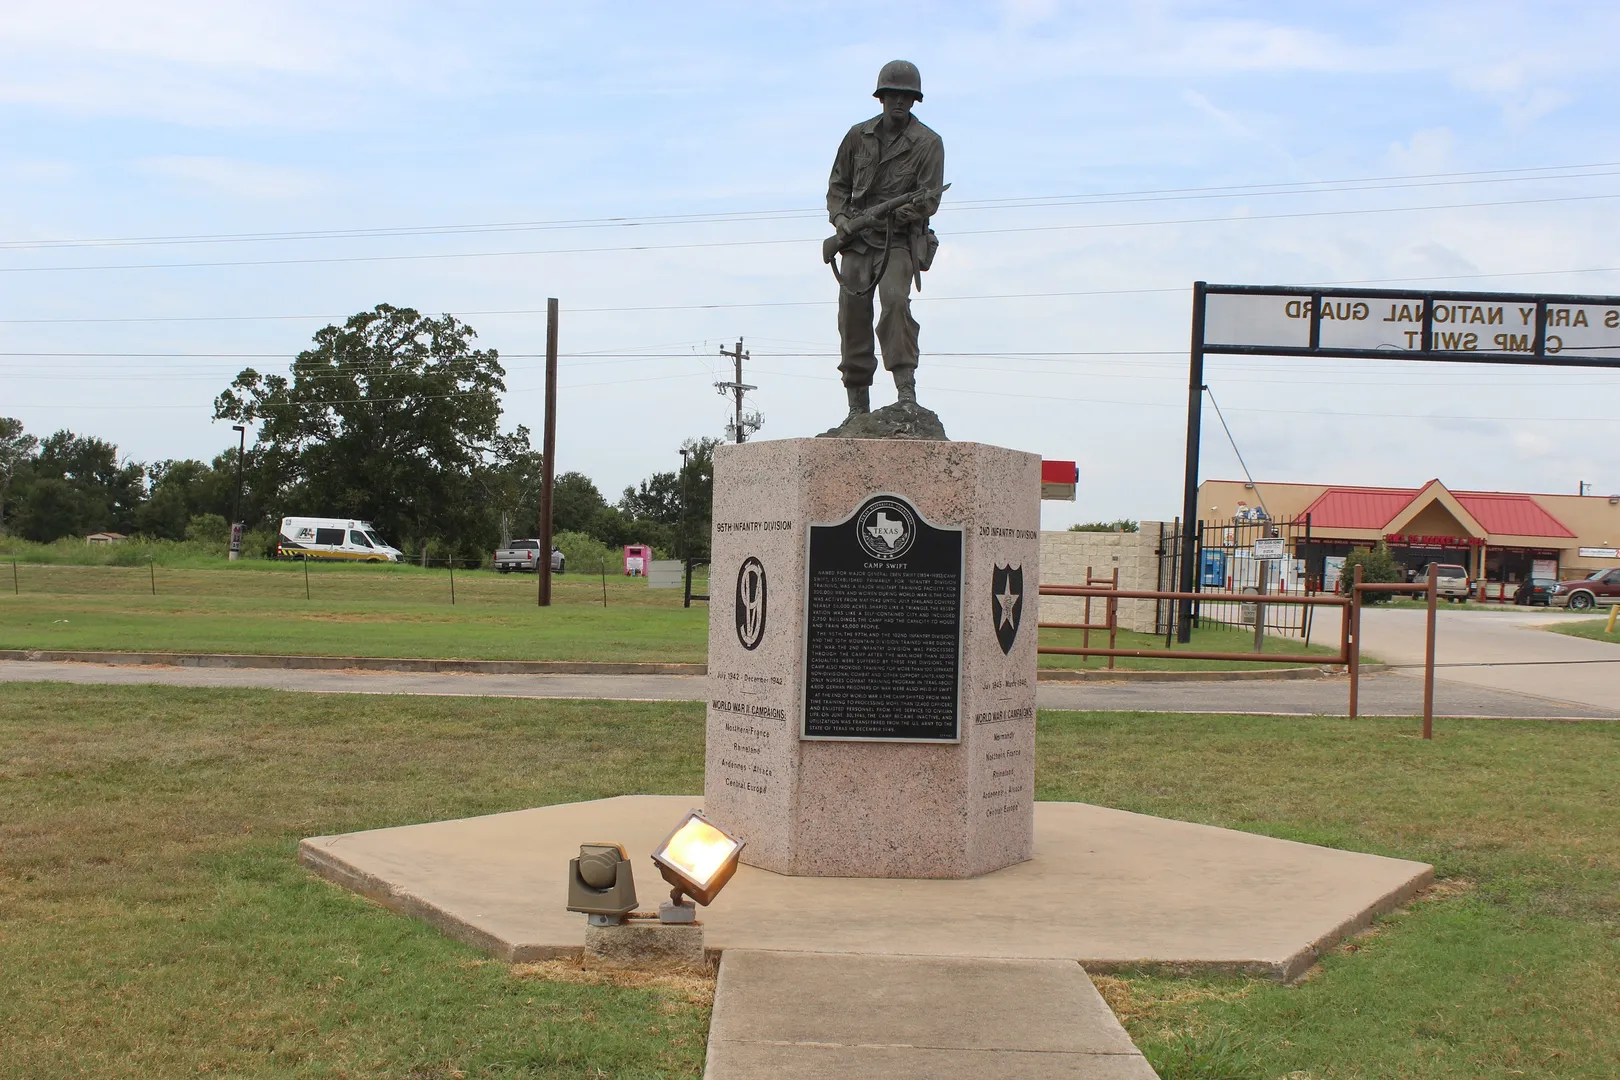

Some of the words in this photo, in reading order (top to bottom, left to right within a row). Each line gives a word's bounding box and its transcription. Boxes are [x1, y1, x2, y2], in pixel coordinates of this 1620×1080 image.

[716, 522, 732, 532] 95TH
[733, 522, 762, 531] INFANTRY
[764, 521, 792, 531] DIVISION
[991, 528, 1014, 538] INFANTRY
[1016, 529, 1037, 539] DIVISION
[1422, 536, 1455, 544] MARKET
[728, 672, 740, 680] 1942
[744, 674, 768, 684] December
[770, 676, 783, 685] 1942
[712, 700, 732, 711] WORLD
[733, 702, 745, 713] WAR
[975, 713, 991, 723] WORLD
[993, 711, 1002, 720] WAR
[750, 726, 769, 738] France
[726, 778, 746, 789] Central
